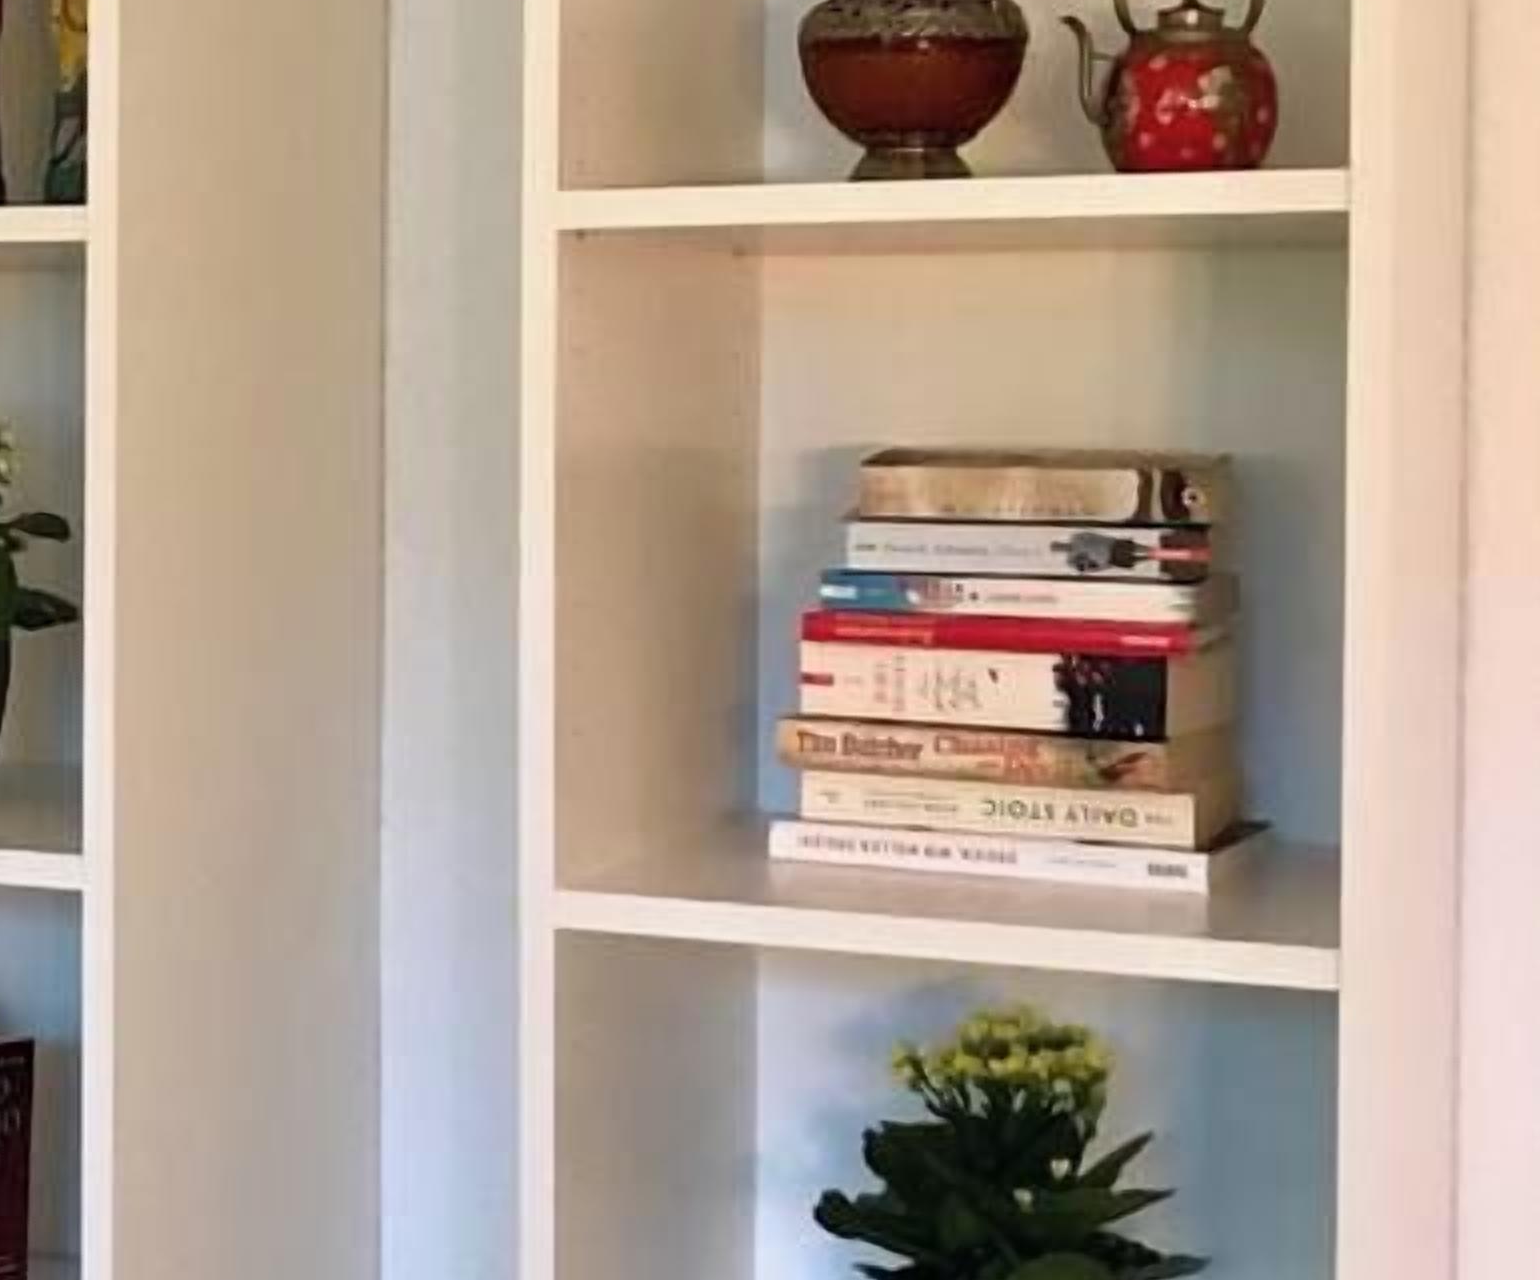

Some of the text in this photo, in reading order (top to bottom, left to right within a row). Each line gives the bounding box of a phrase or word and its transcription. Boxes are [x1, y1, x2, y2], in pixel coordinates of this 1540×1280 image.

[841, 731, 924, 760] Butcher
[981, 799, 1055, 820] STOIC
[1064, 804, 1139, 828] DAILY
